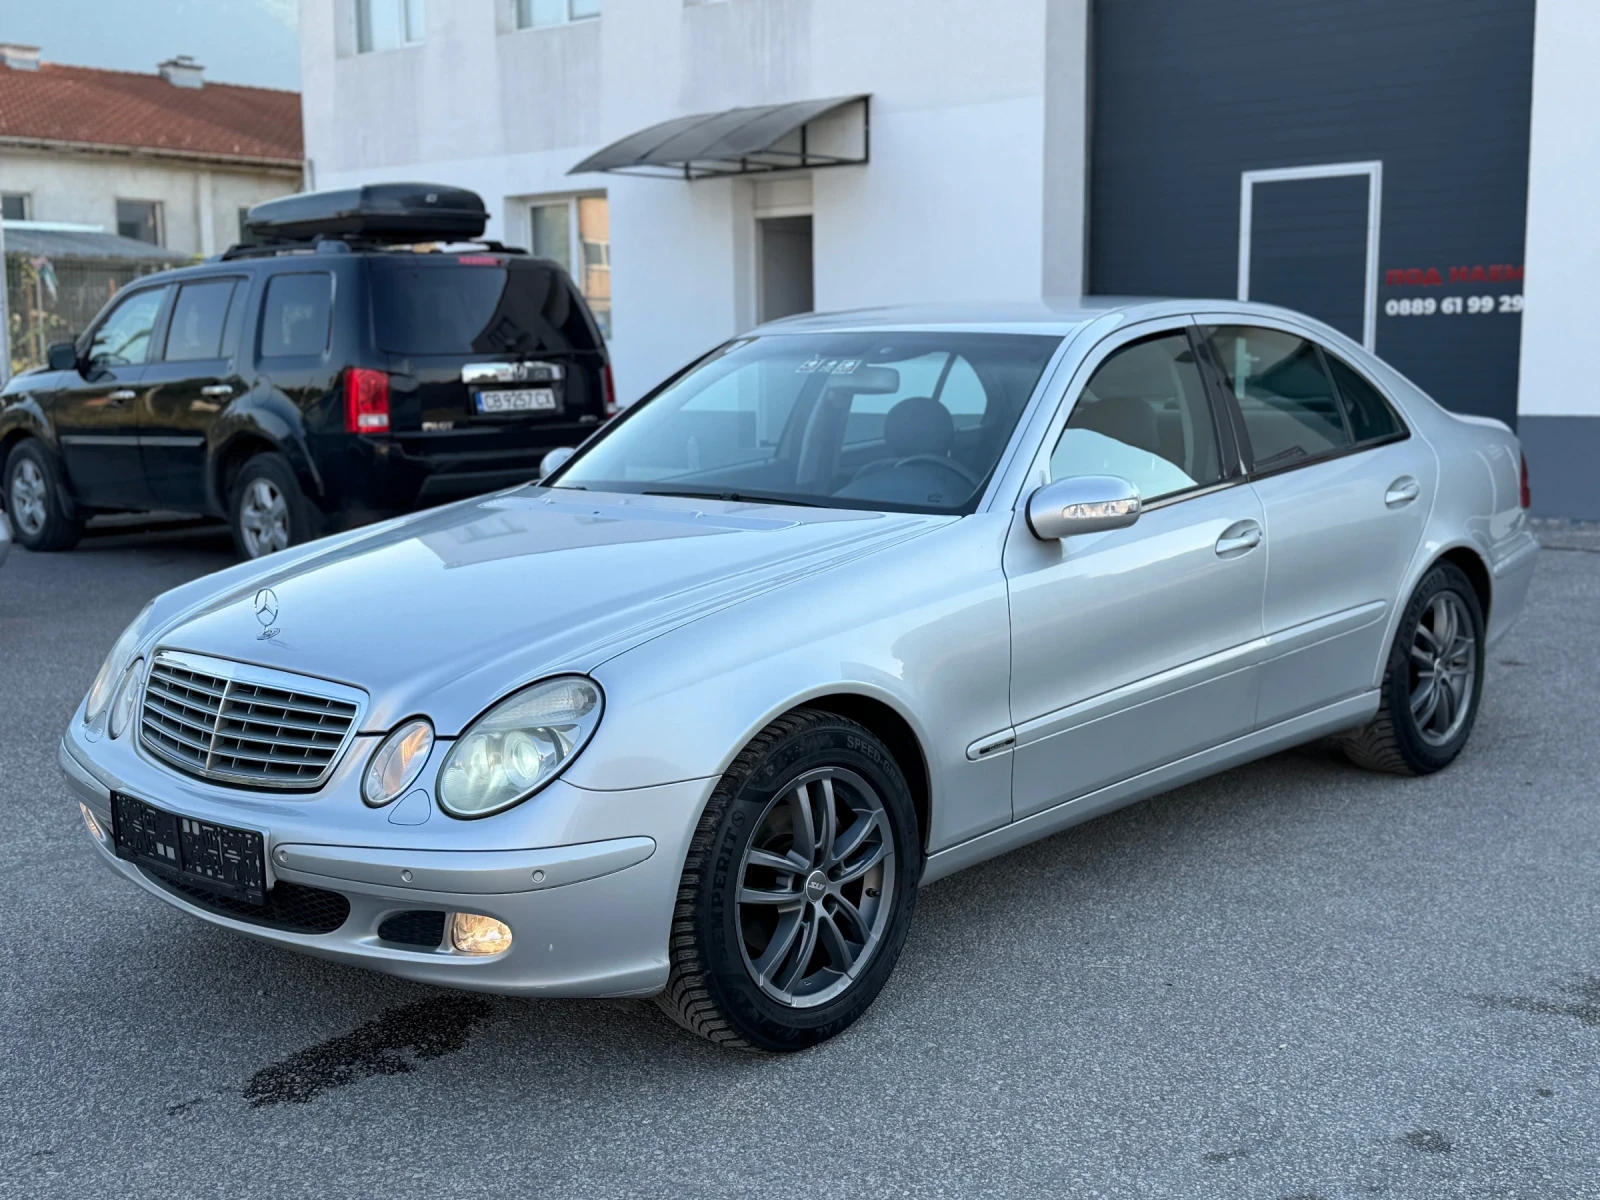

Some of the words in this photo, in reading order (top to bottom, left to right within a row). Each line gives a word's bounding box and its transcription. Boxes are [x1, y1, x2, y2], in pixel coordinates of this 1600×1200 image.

[1386, 268, 1443, 287] ПОД
[1385, 298, 1437, 316] 0889
[1441, 296, 1463, 314] 61
[1467, 295, 1495, 314] 99
[1498, 294, 1524, 313] 29
[711, 827, 737, 962] SEMPERIT
